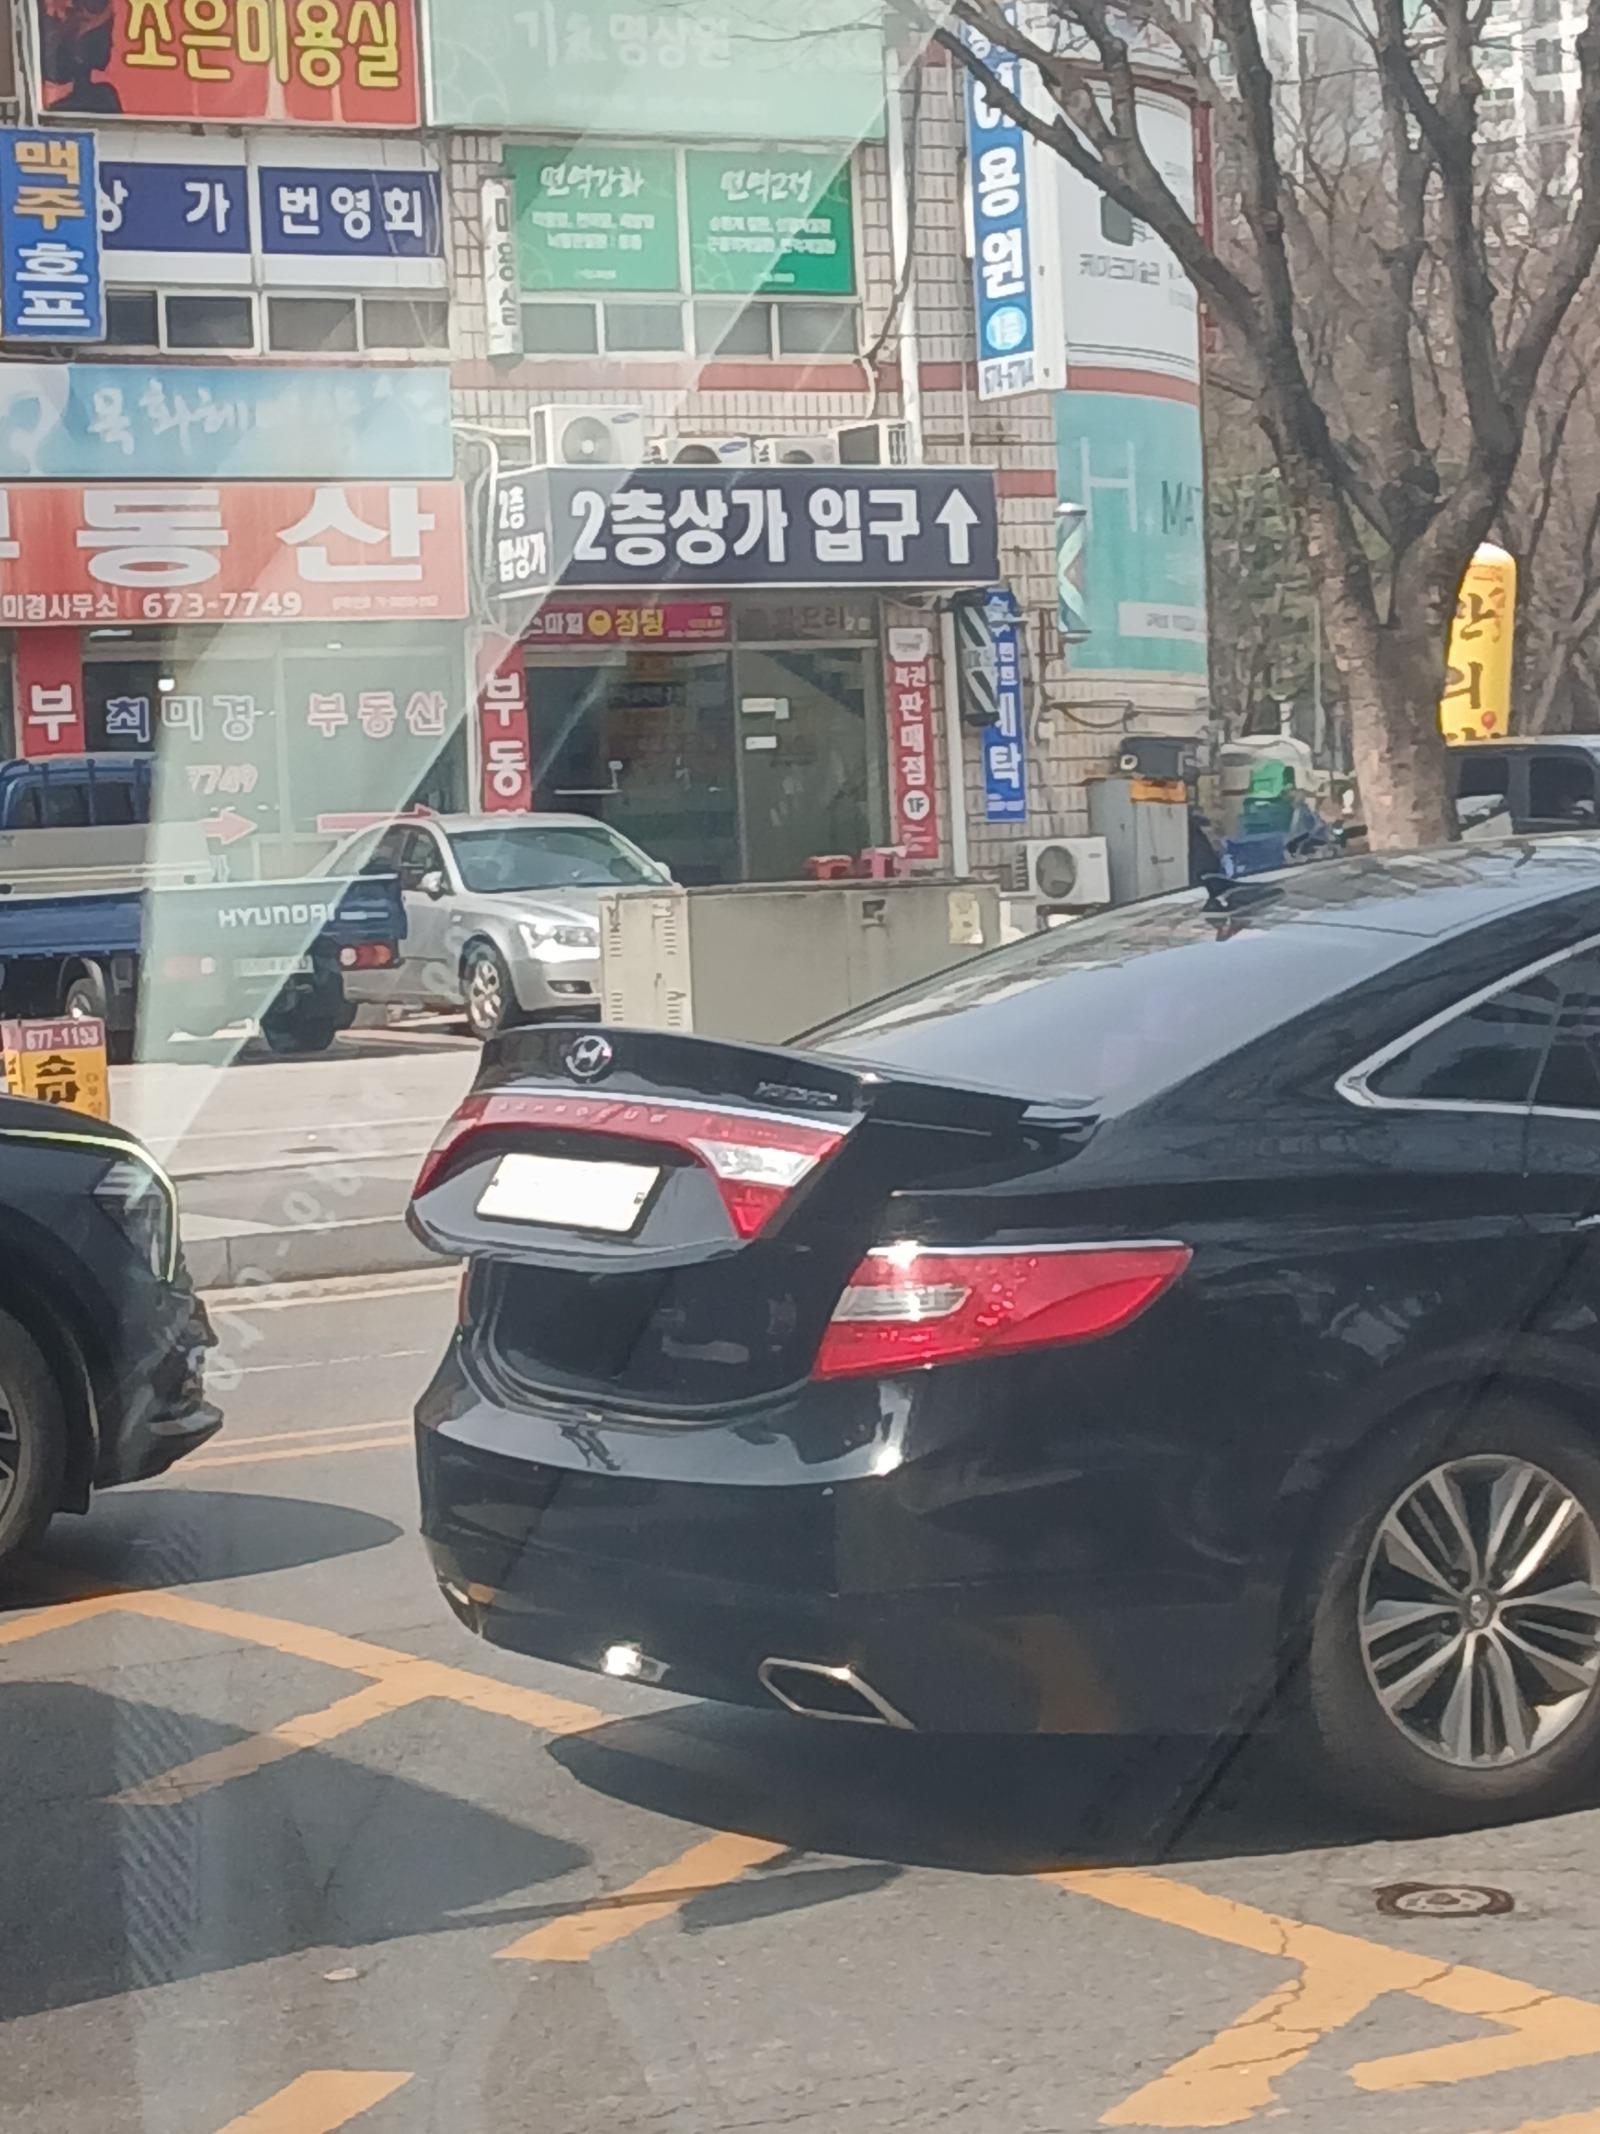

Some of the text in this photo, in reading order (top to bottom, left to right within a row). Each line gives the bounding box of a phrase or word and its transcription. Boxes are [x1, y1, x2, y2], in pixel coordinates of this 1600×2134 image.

[14, 140, 91, 329] 맥주 호프
[279, 185, 423, 239] 번영회
[0, 487, 436, 588] 동산
[571, 488, 921, 567] 2층상가 입구
[142, 592, 303, 618] 673-7749
[28, 684, 78, 743] 부
[306, 690, 450, 740] 부동산
[482, 671, 530, 813] 부동
